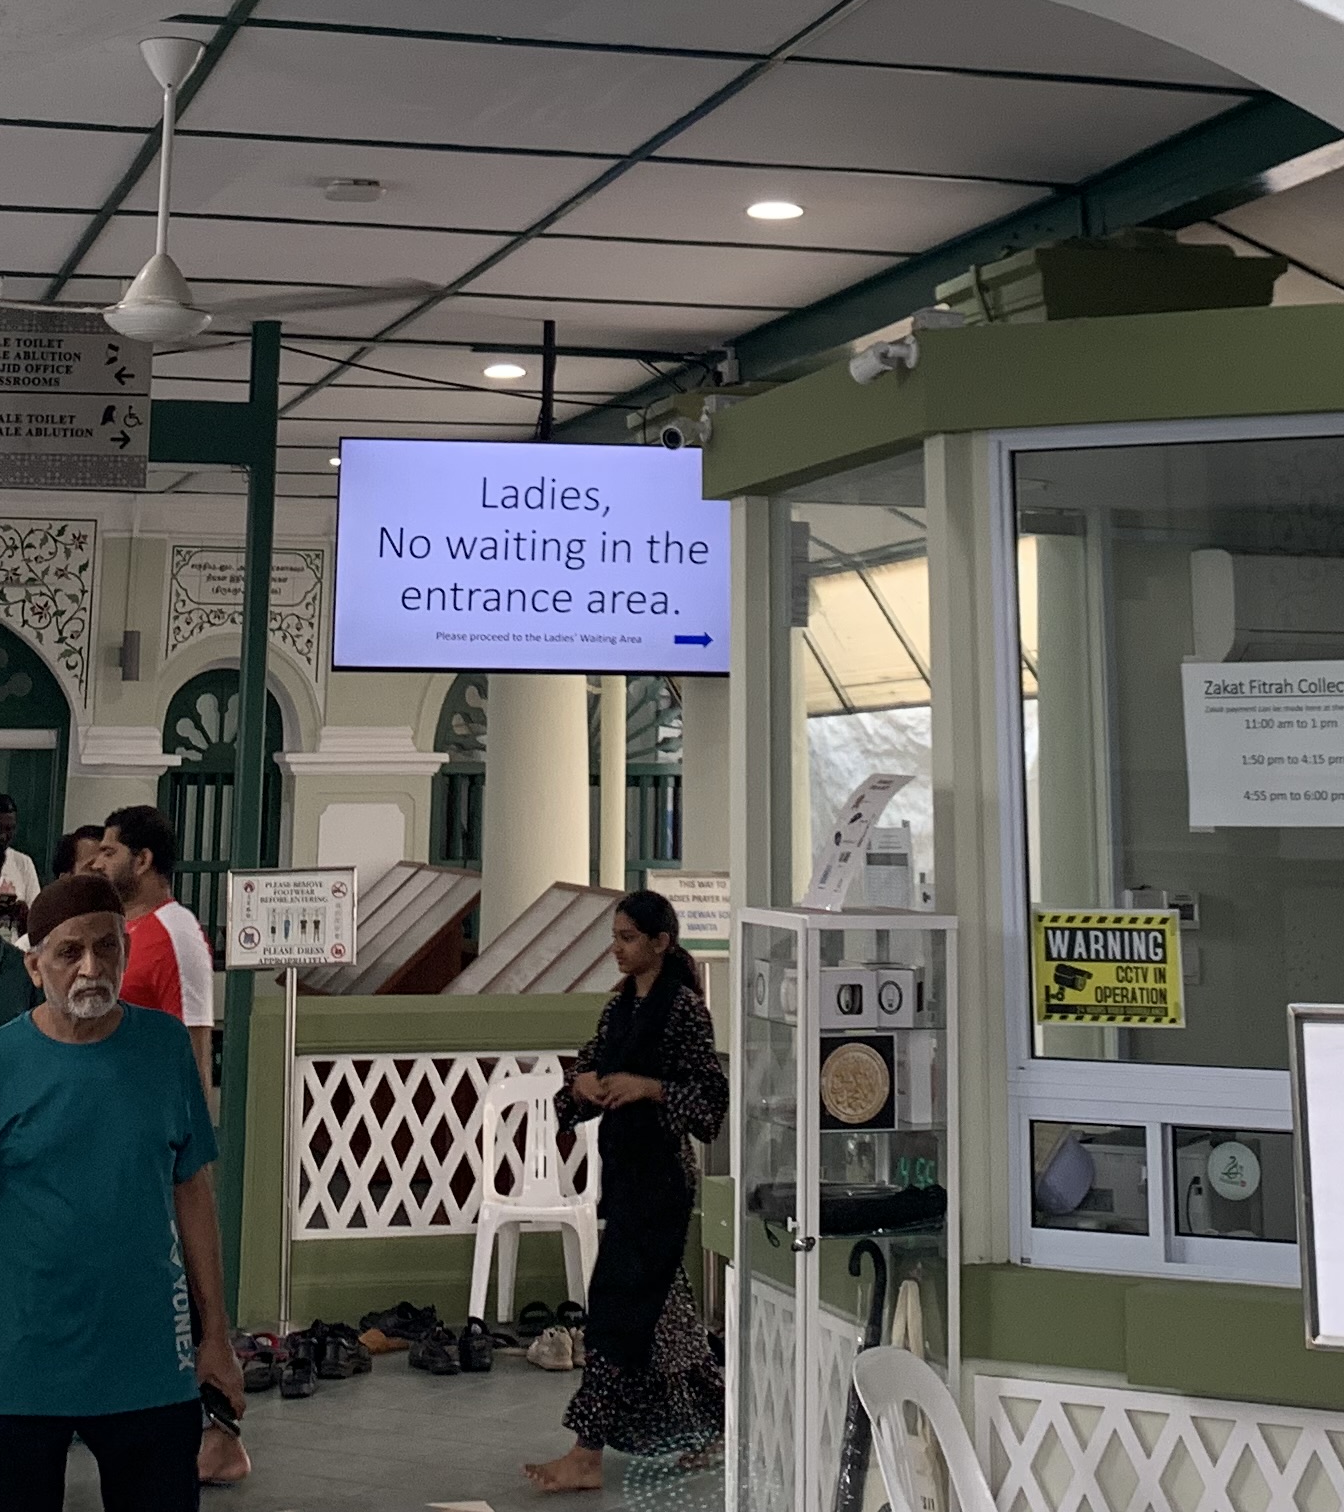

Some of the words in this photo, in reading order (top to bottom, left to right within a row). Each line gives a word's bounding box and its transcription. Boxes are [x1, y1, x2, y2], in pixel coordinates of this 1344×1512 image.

[16, 338, 64, 349] TOILET
[13, 351, 82, 362] ABLUTION
[24, 363, 74, 375] OFFICE
[26, 413, 76, 425] TOILET
[24, 426, 94, 438] ABLUTION
[481, 475, 611, 518] Ladies,
[378, 525, 432, 561] No
[445, 529, 587, 571] waiting
[599, 530, 632, 565] in
[646, 530, 710, 565] the
[400, 581, 574, 615] entrance
[586, 585, 682, 616] area.
[436, 631, 468, 642] Please
[469, 632, 511, 644] proceed
[512, 632, 524, 642] to
[525, 632, 542, 643] the
[579, 634, 618, 646] Waiting
[618, 635, 643, 644] Area
[1204, 680, 1245, 696] Zakat
[1249, 678, 1294, 695] Fitrah
[1244, 719, 1274, 730] 11:00
[1276, 720, 1294, 729] am
[1296, 719, 1308, 729] to
[1311, 719, 1317, 728] 1
[1319, 720, 1339, 731] pm
[1242, 754, 1265, 766] 1:50
[1267, 756, 1285, 767] pm
[1287, 755, 1299, 765] to
[1300, 754, 1326, 766] 4:15
[1243, 791, 1267, 802] 4:55
[1269, 792, 1288, 803] pm
[1289, 791, 1302, 801] to
[1303, 791, 1329, 802] 6:00
[264, 881, 291, 889] PLEASE
[678, 879, 696, 888] THIS
[697, 880, 714, 888] WAY
[716, 880, 728, 888] TO
[273, 888, 315, 896] FOOTWEAR
[259, 896, 288, 904] BEFORE
[288, 896, 329, 904] ENTERING
[668, 894, 691, 903] ADIES
[691, 894, 720, 904] PRAYER
[687, 910, 717, 920] DEWAN
[262, 947, 293, 956] PLEASE
[296, 947, 325, 956] DRESS
[1047, 929, 1164, 962] WARNING
[1115, 965, 1149, 984] CCTV
[1154, 966, 1167, 984] IN
[1094, 985, 1168, 1005] OPERATION
[172, 1273, 196, 1372] YONEX
